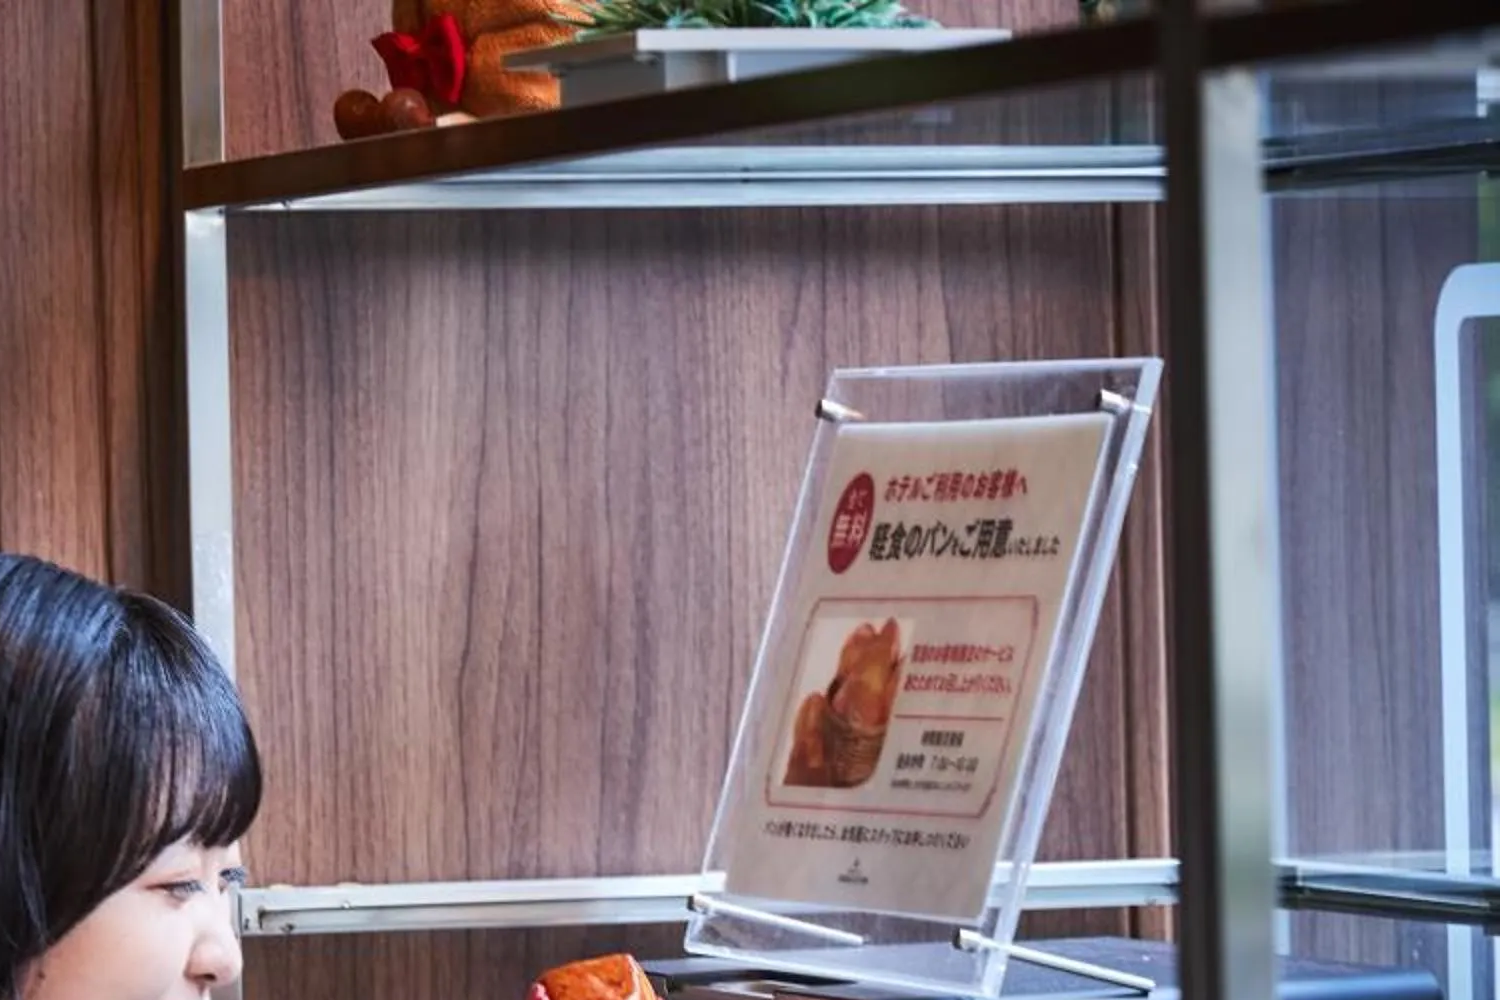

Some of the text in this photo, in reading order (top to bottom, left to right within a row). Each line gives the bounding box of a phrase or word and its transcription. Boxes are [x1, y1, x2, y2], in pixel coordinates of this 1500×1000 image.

[883, 468, 1028, 502] ホテルご利用のお客様へ
